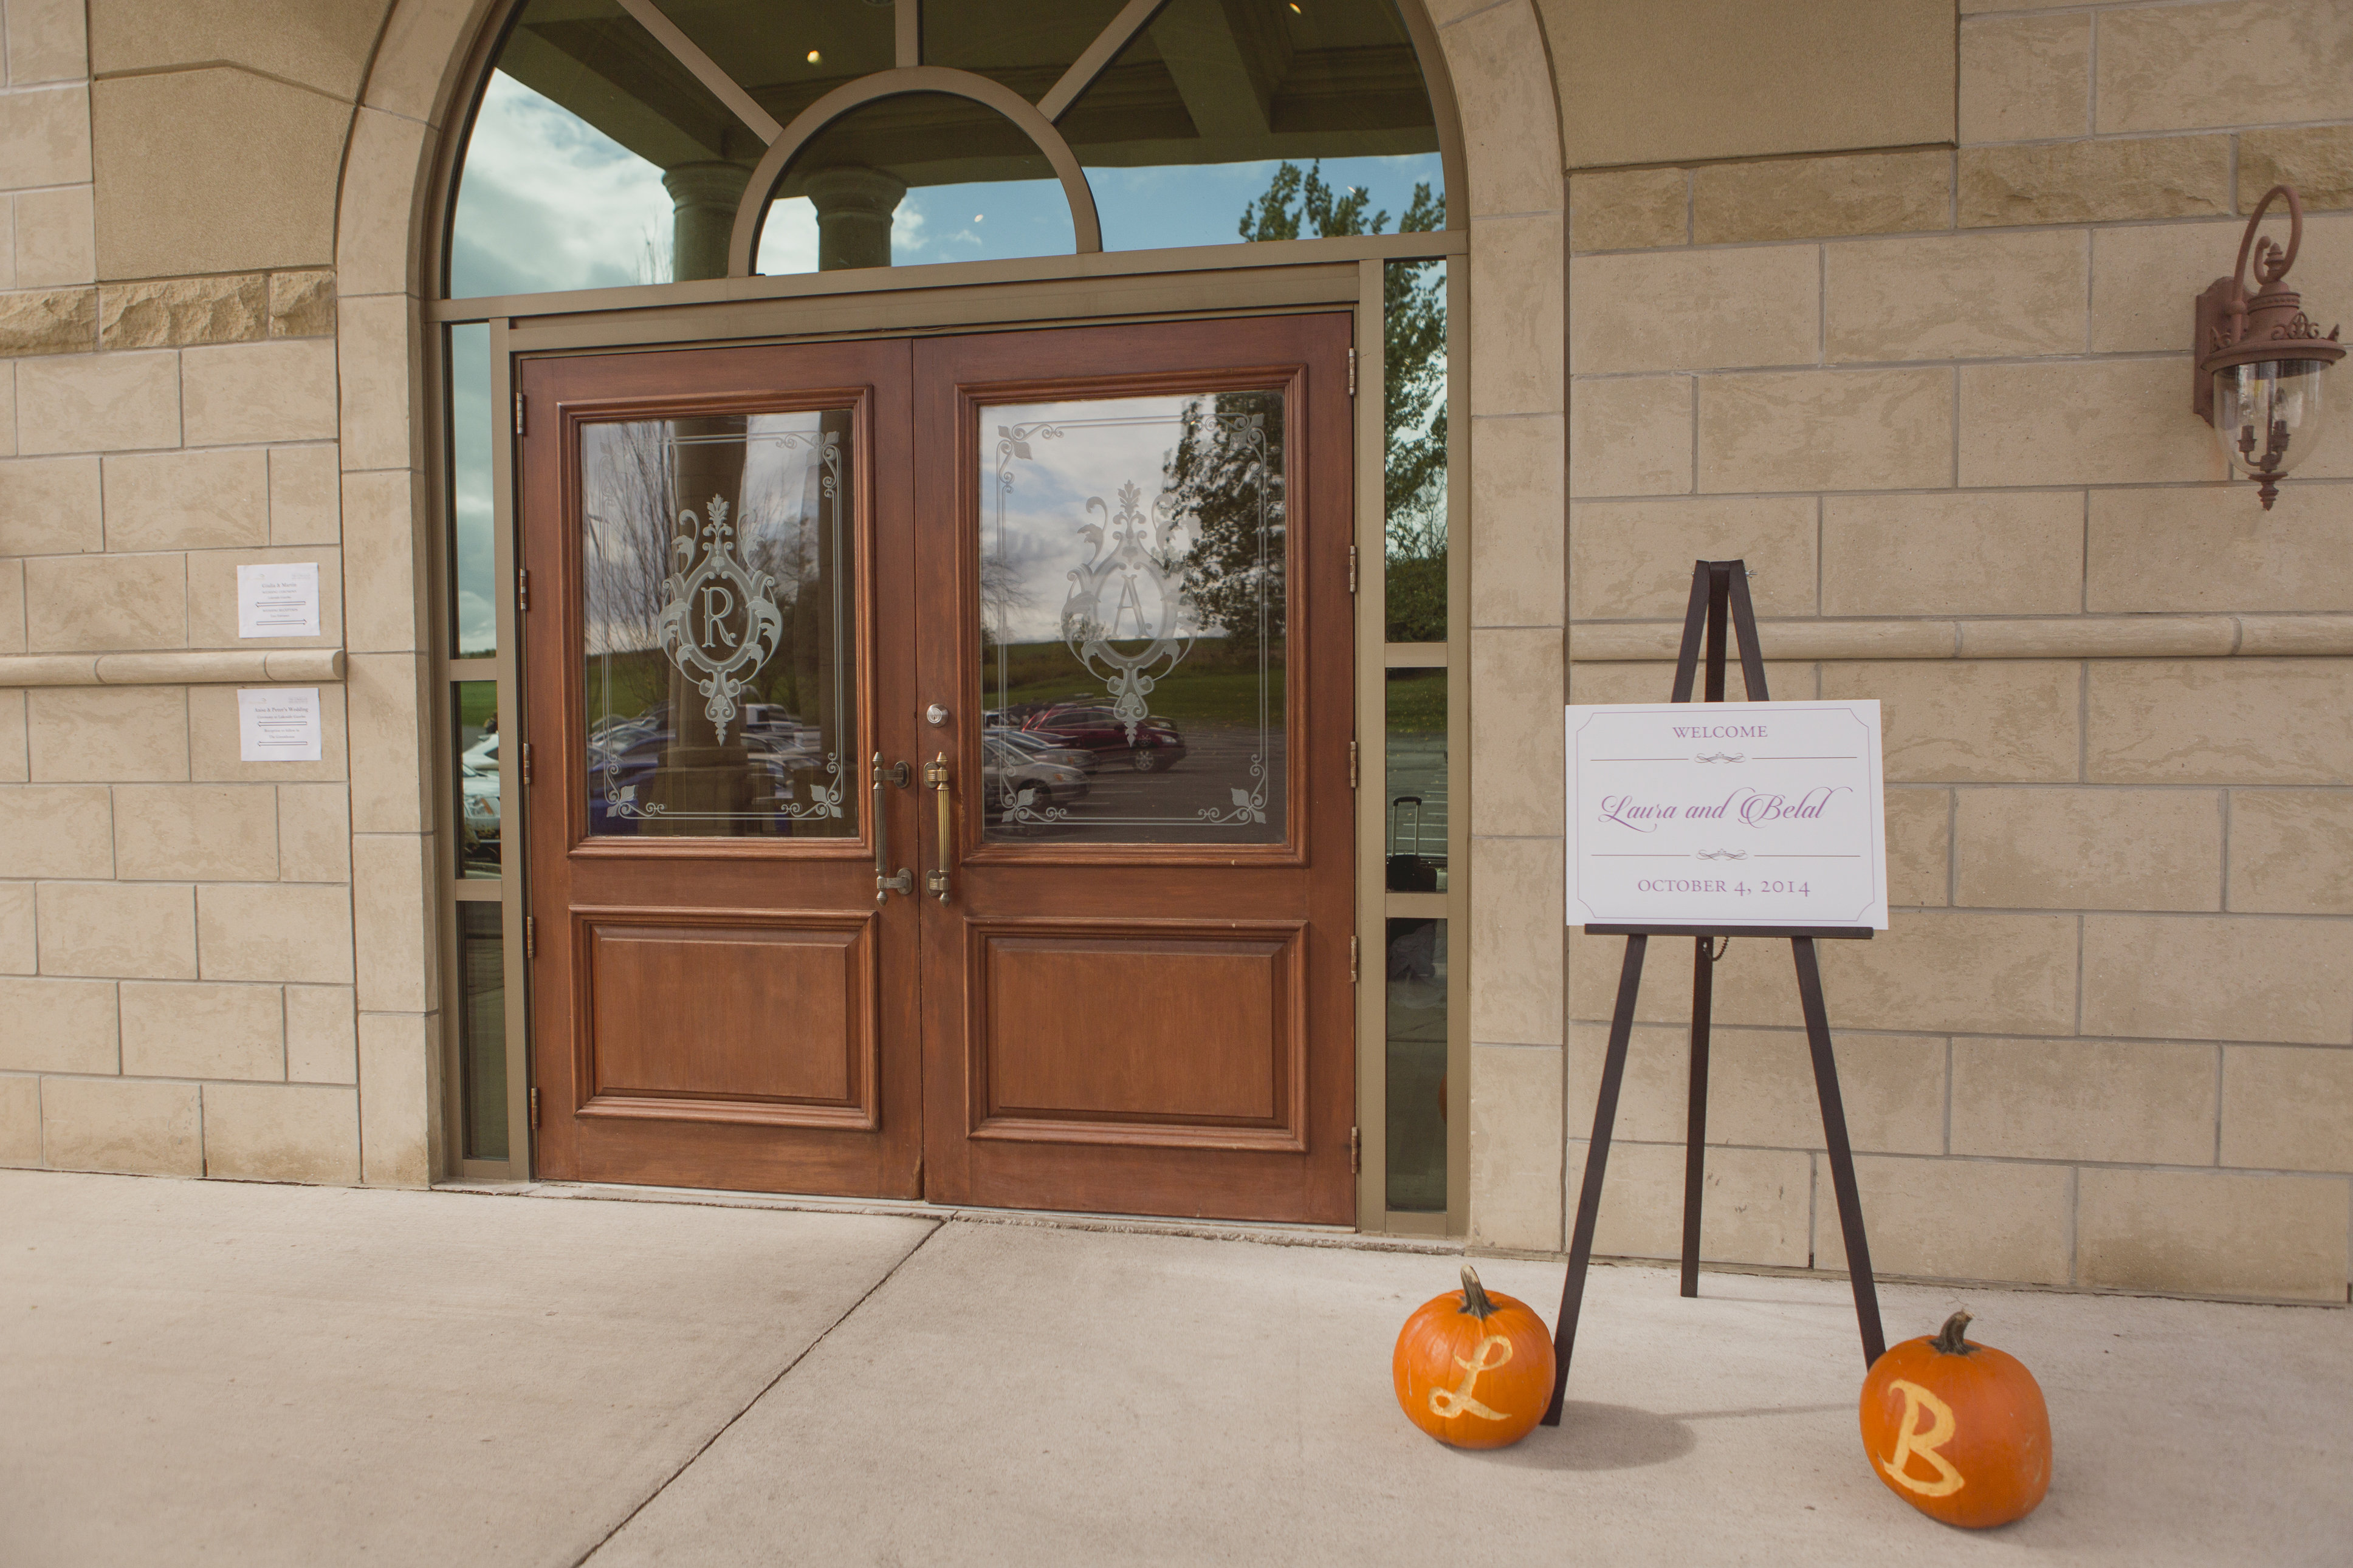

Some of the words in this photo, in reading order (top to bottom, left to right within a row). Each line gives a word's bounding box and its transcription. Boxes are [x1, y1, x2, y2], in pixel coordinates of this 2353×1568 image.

[700, 586, 738, 649] R
[1111, 573, 1153, 639] A
[1672, 725, 1768, 739] WELCOME
[1598, 795, 1677, 833] Laura
[1685, 787, 1756, 820] and
[1737, 786, 1853, 829] Belal
[1637, 878, 1726, 893] OCTOBER
[1734, 880, 1751, 896] 4,
[1760, 880, 1811, 897] 2014
[1427, 1334, 1514, 1422] L
[1877, 1378, 1966, 1498] B
